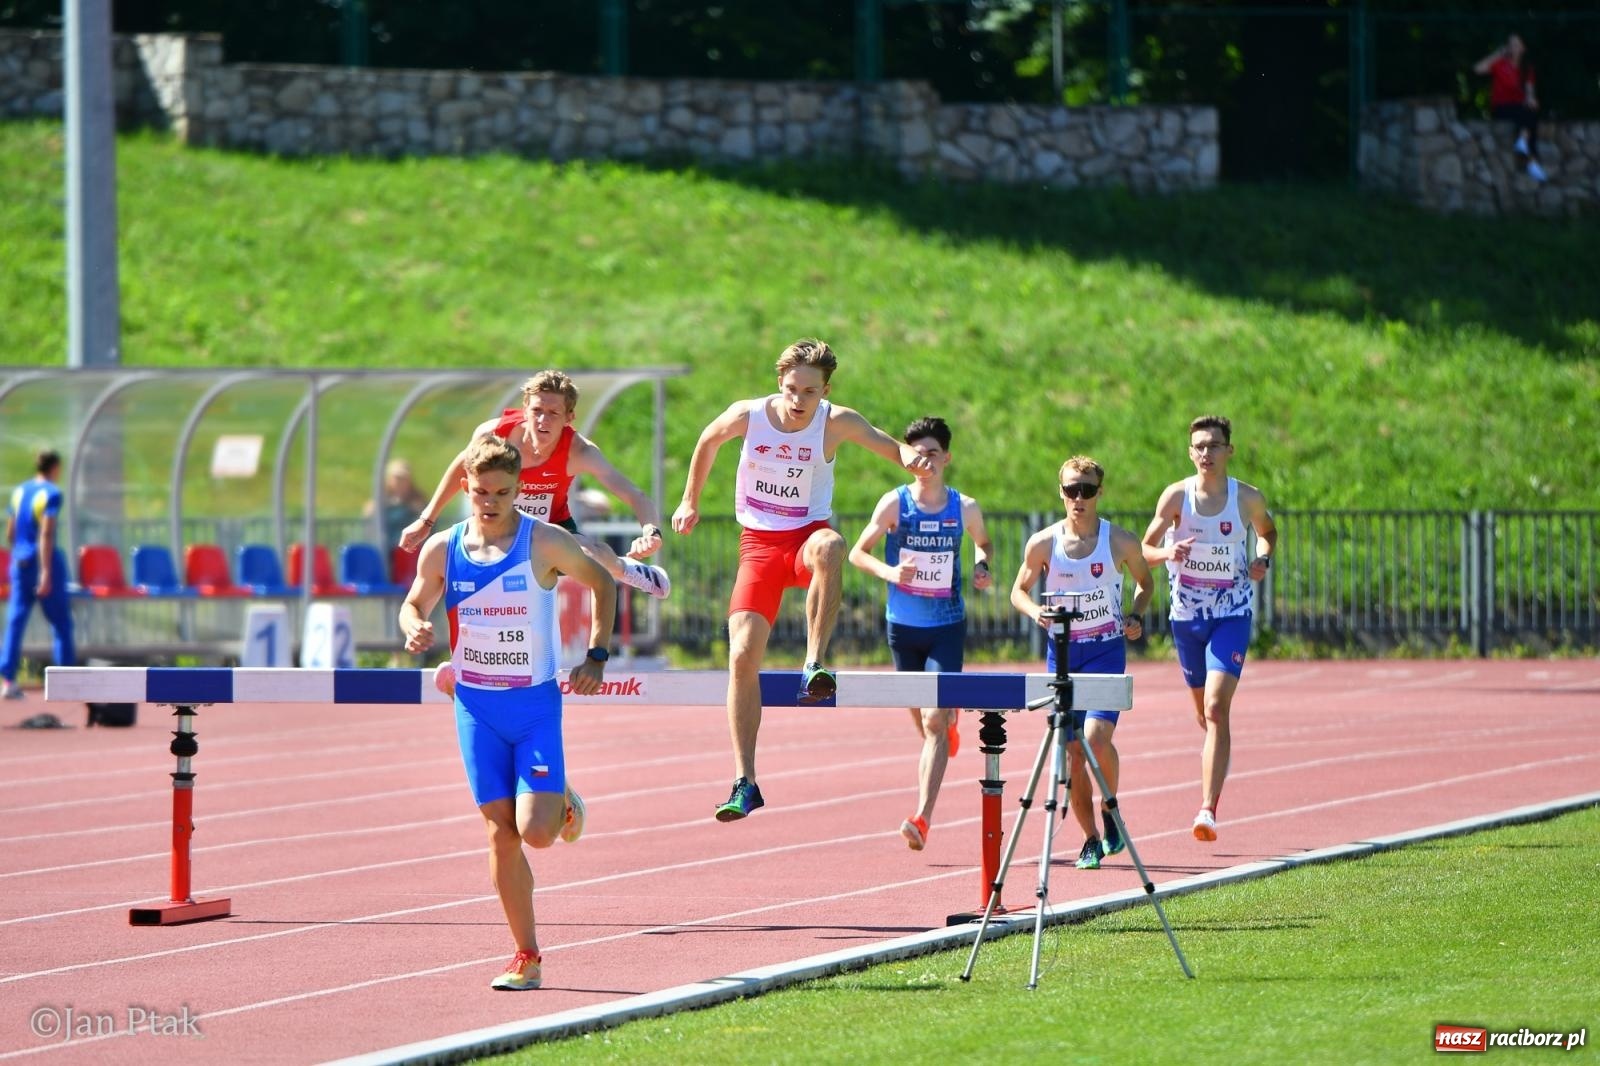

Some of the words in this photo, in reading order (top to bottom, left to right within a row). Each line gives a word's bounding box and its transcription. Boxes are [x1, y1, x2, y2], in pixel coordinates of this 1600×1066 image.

[787, 467, 803, 478] 57
[756, 480, 800, 498] RULKA
[906, 535, 953, 547] CROATIA
[1211, 546, 1230, 555] 361
[930, 554, 949, 564] 557
[916, 568, 942, 581] RLIĆ
[1084, 590, 1105, 603] 362
[484, 606, 527, 616] REPUBLIC
[498, 630, 524, 642] 158
[256, 623, 277, 667] 1
[335, 622, 353, 667] 2
[464, 647, 529, 665] EDELSBERGER
